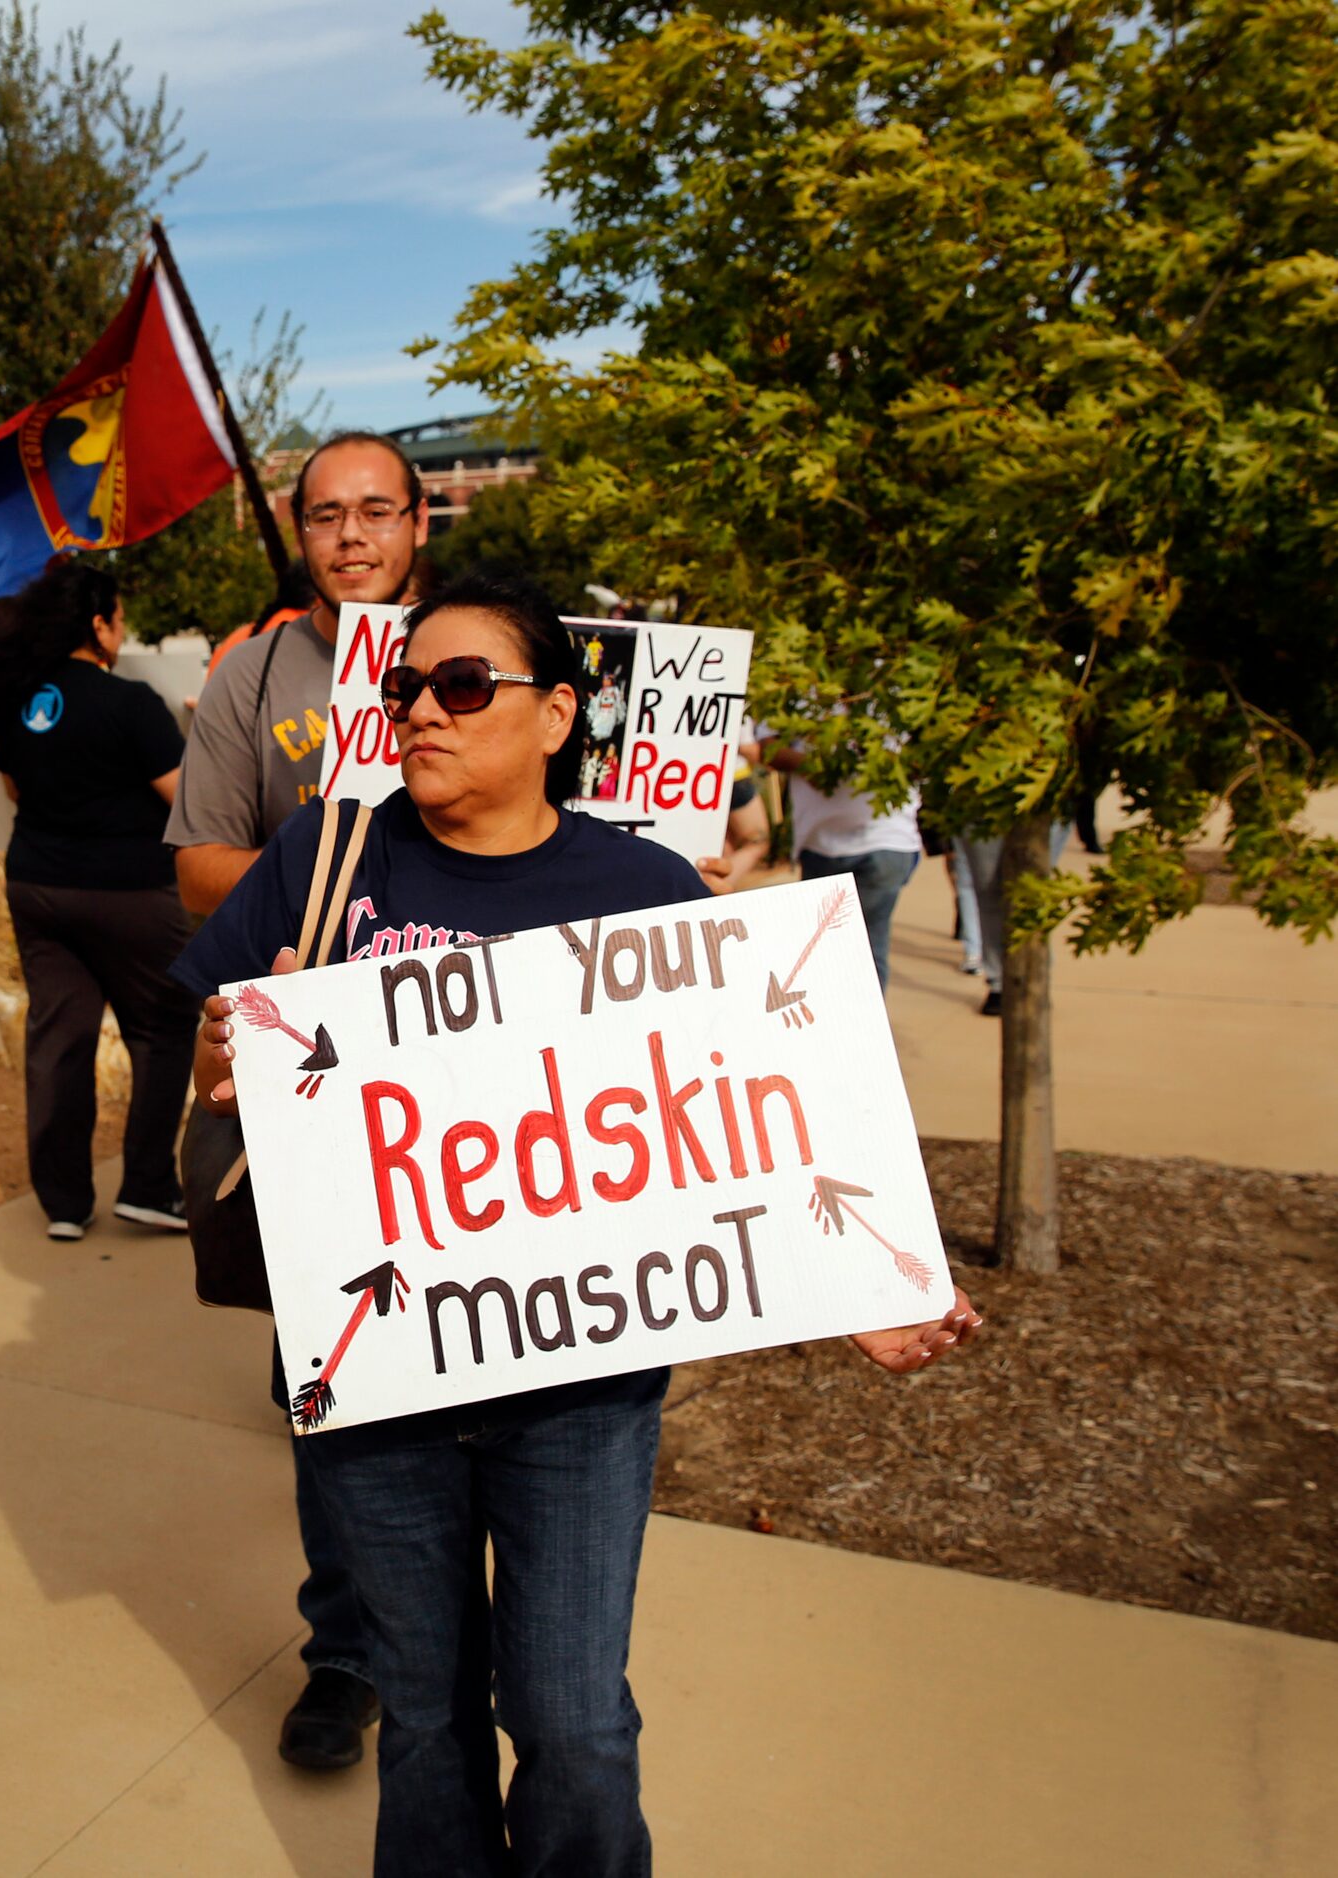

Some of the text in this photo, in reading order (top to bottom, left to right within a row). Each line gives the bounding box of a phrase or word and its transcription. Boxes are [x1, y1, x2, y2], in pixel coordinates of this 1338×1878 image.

[648, 632, 726, 683] We
[636, 688, 745, 738] R NOT
[625, 741, 728, 814] Red
[557, 917, 749, 1015] Your
[361, 1031, 814, 1251] Redskin
